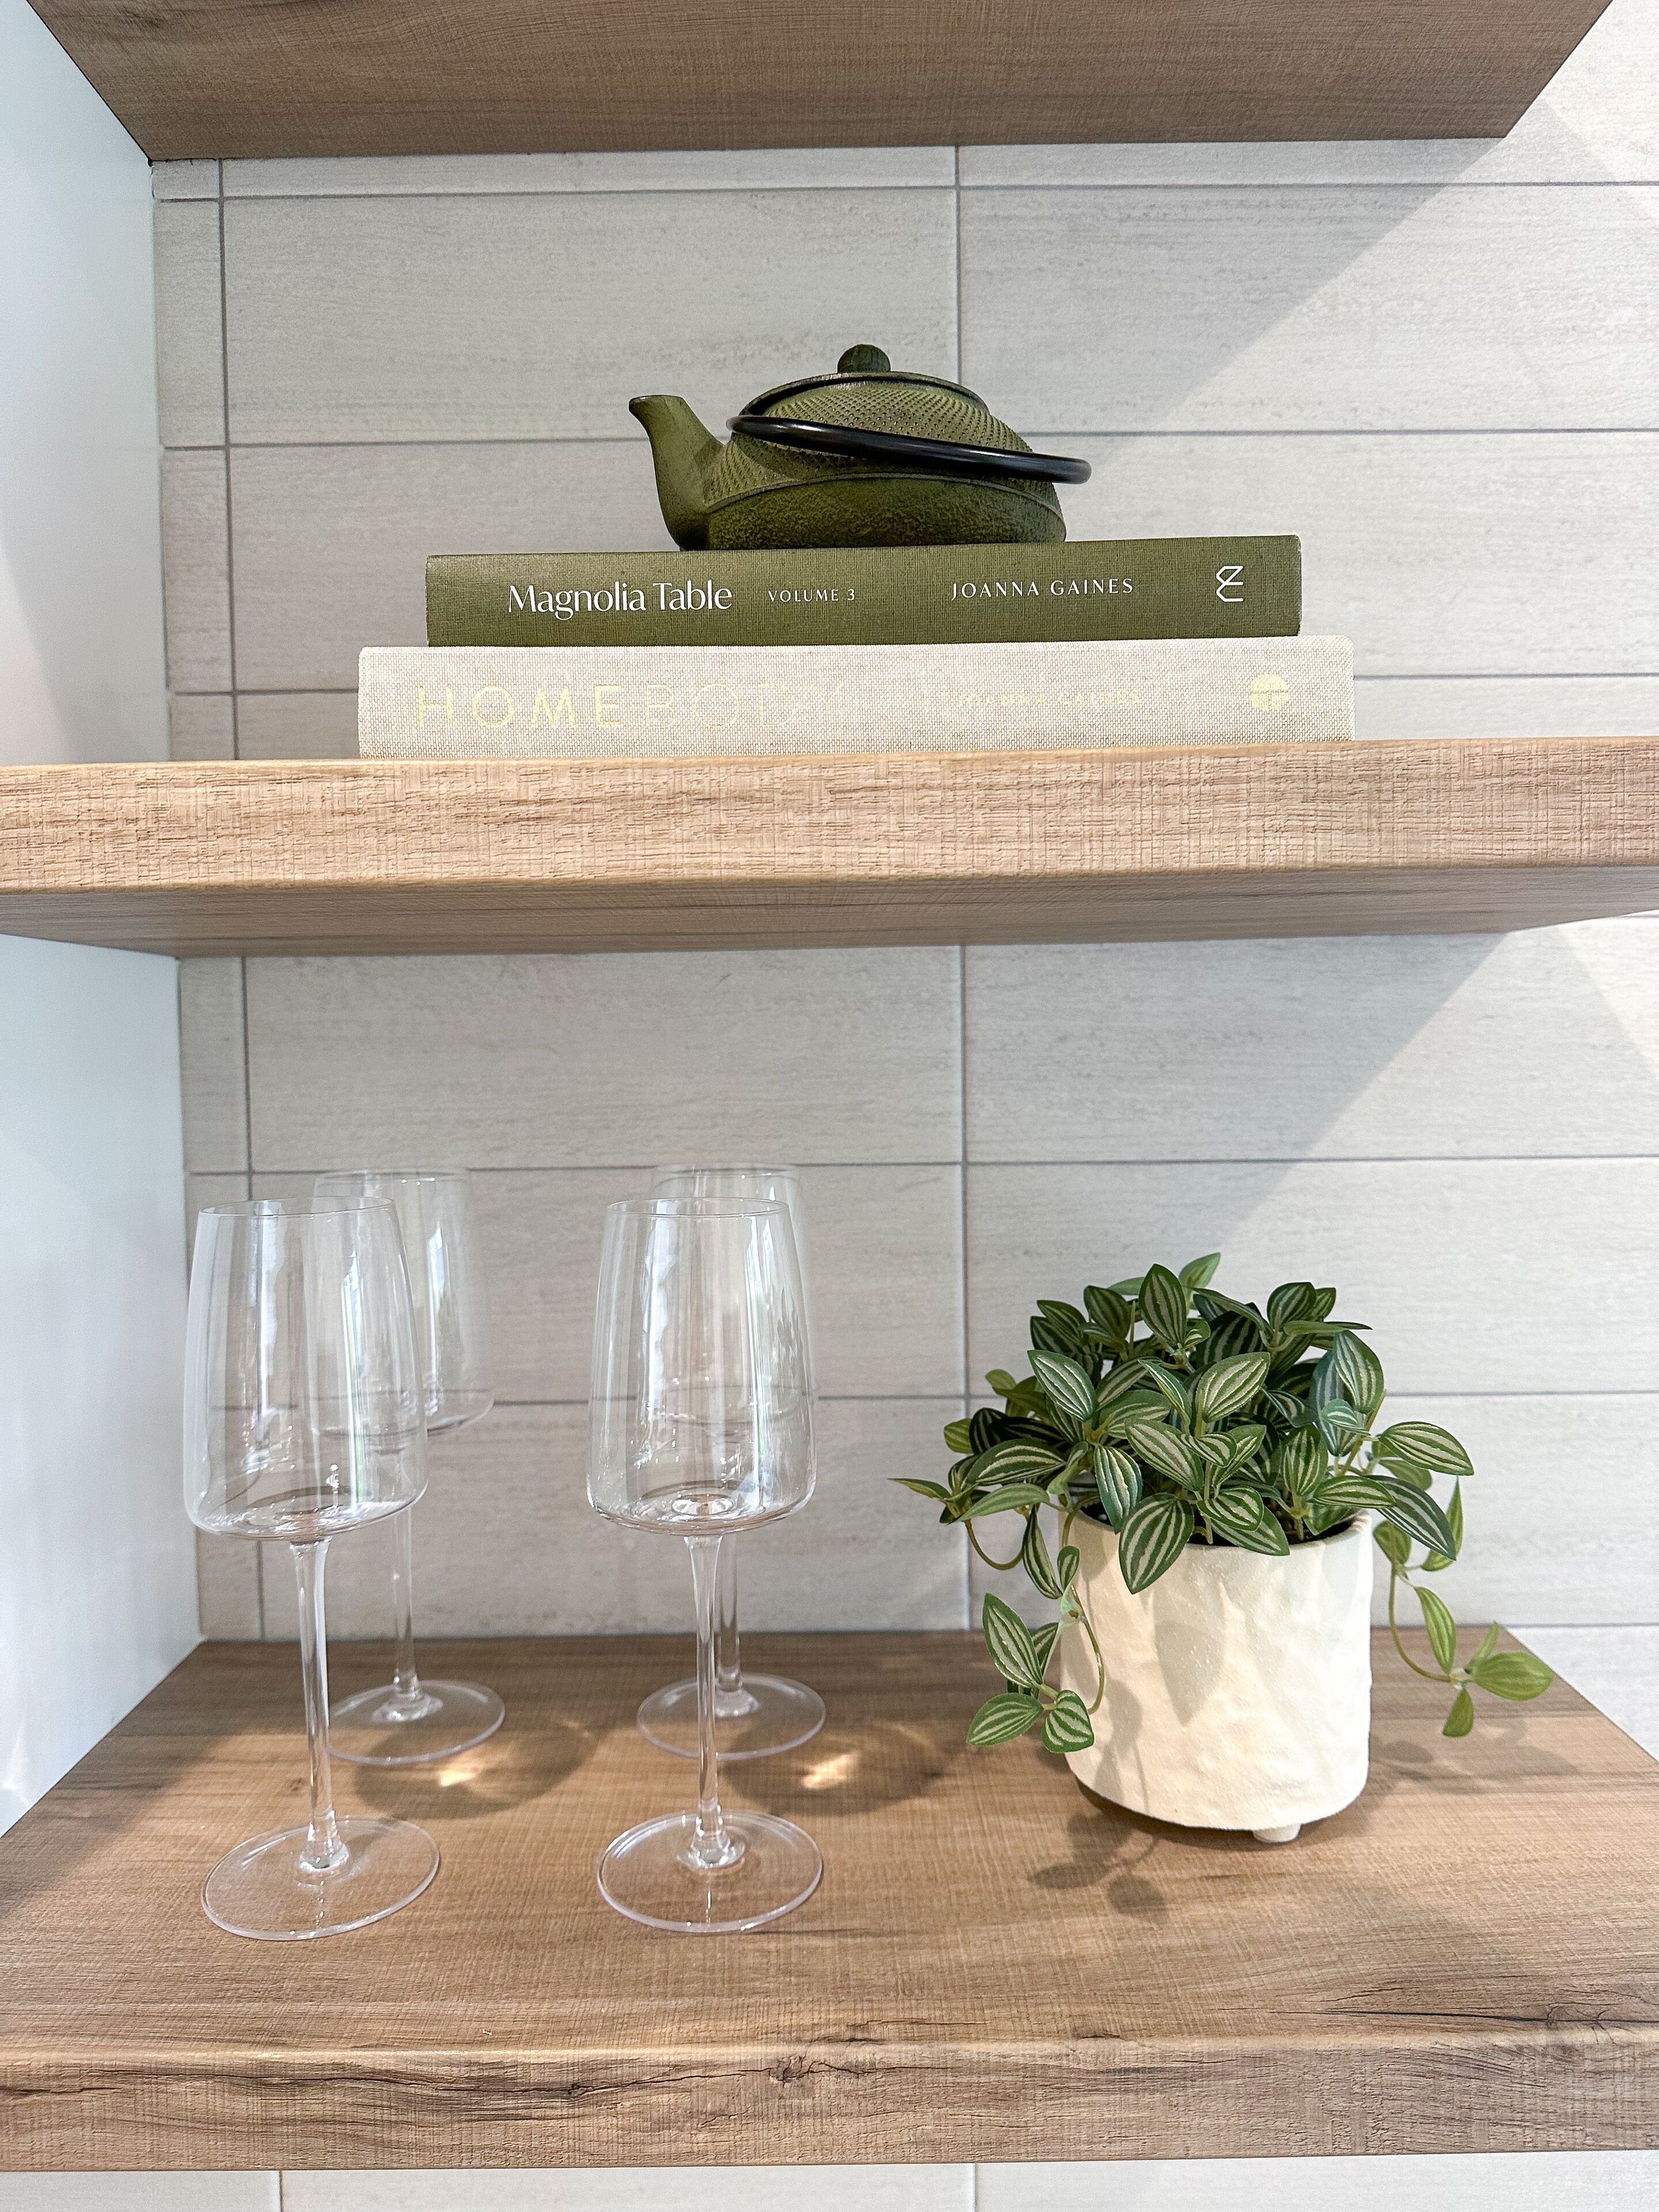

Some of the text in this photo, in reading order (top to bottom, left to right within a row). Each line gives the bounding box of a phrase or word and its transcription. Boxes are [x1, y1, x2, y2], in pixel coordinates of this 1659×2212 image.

[508, 579, 733, 620] Magnolia Table
[767, 588, 855, 603] VOLUME 3
[950, 578, 1134, 601] JOANNA GAINES
[416, 681, 843, 728] HOMEBODY
